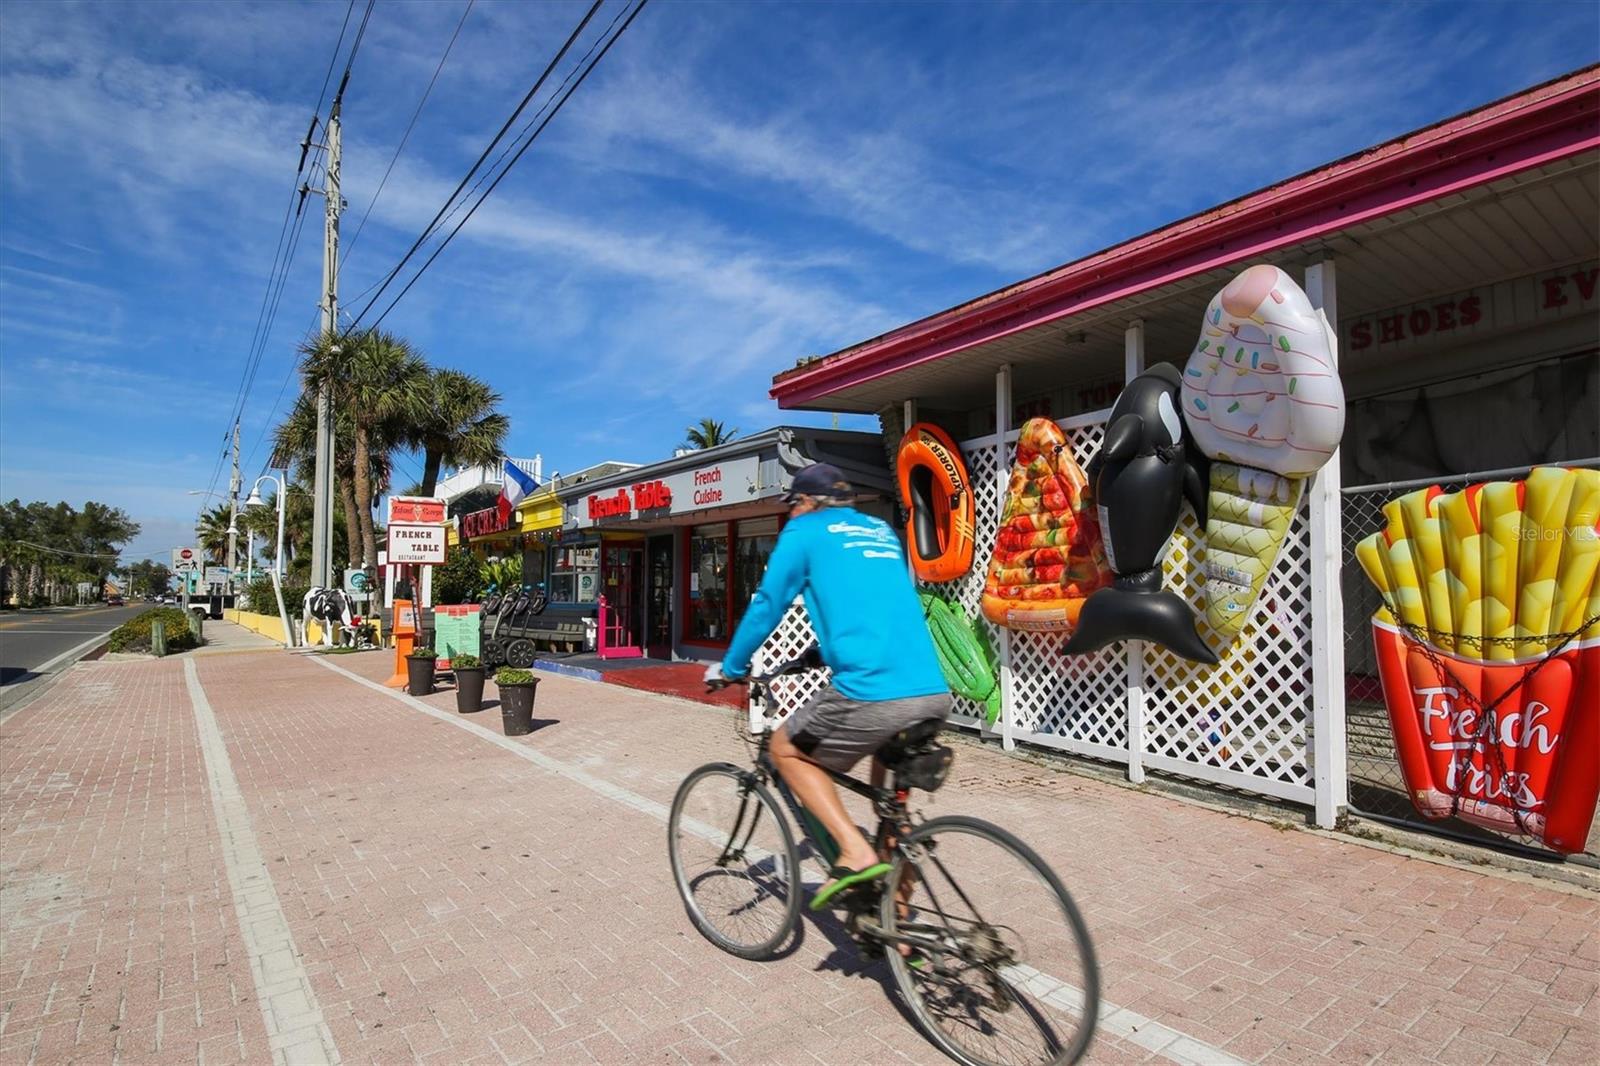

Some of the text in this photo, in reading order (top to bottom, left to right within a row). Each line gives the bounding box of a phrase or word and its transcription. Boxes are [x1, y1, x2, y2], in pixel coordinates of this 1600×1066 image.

[1350, 268, 1600, 351] SHOES EV
[694, 467, 721, 486] French
[588, 479, 673, 520] French Table
[693, 487, 722, 505] Cuisine
[395, 531, 432, 539] FRENCH
[463, 514, 476, 538] ICE
[411, 544, 440, 552] TABLE
[1413, 685, 1559, 754] French
[1430, 740, 1545, 808] Fries
